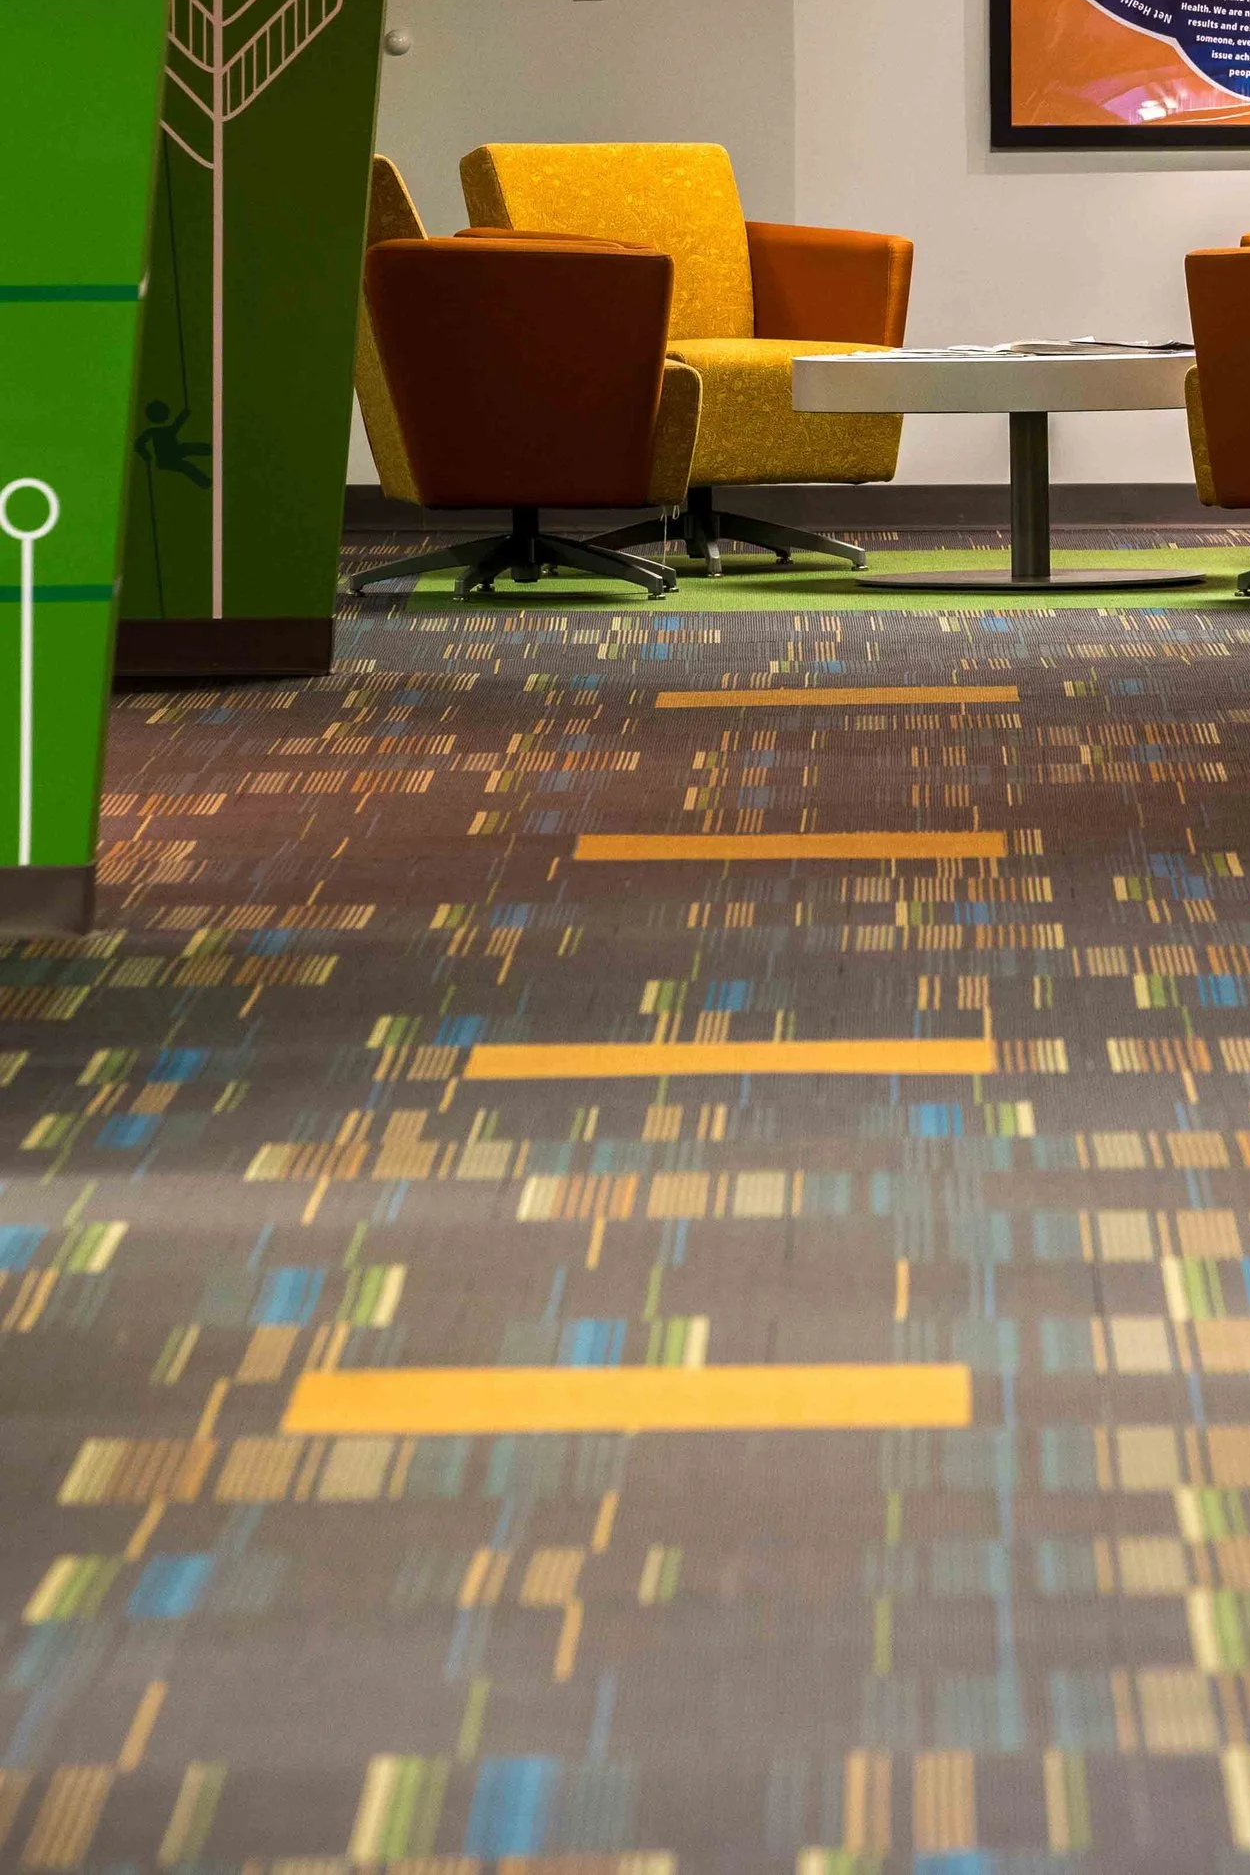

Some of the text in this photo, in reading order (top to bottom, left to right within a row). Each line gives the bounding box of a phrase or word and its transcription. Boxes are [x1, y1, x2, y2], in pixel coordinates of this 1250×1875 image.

[1180, 2, 1211, 13] Health.
[1213, 6, 1227, 15] We
[1228, 9, 1243, 17] are
[1154, 9, 1172, 24] Net
[1187, 19, 1219, 29] results
[1220, 22, 1238, 31] and
[1196, 35, 1235, 45] someone,
[1211, 50, 1233, 60] issue
